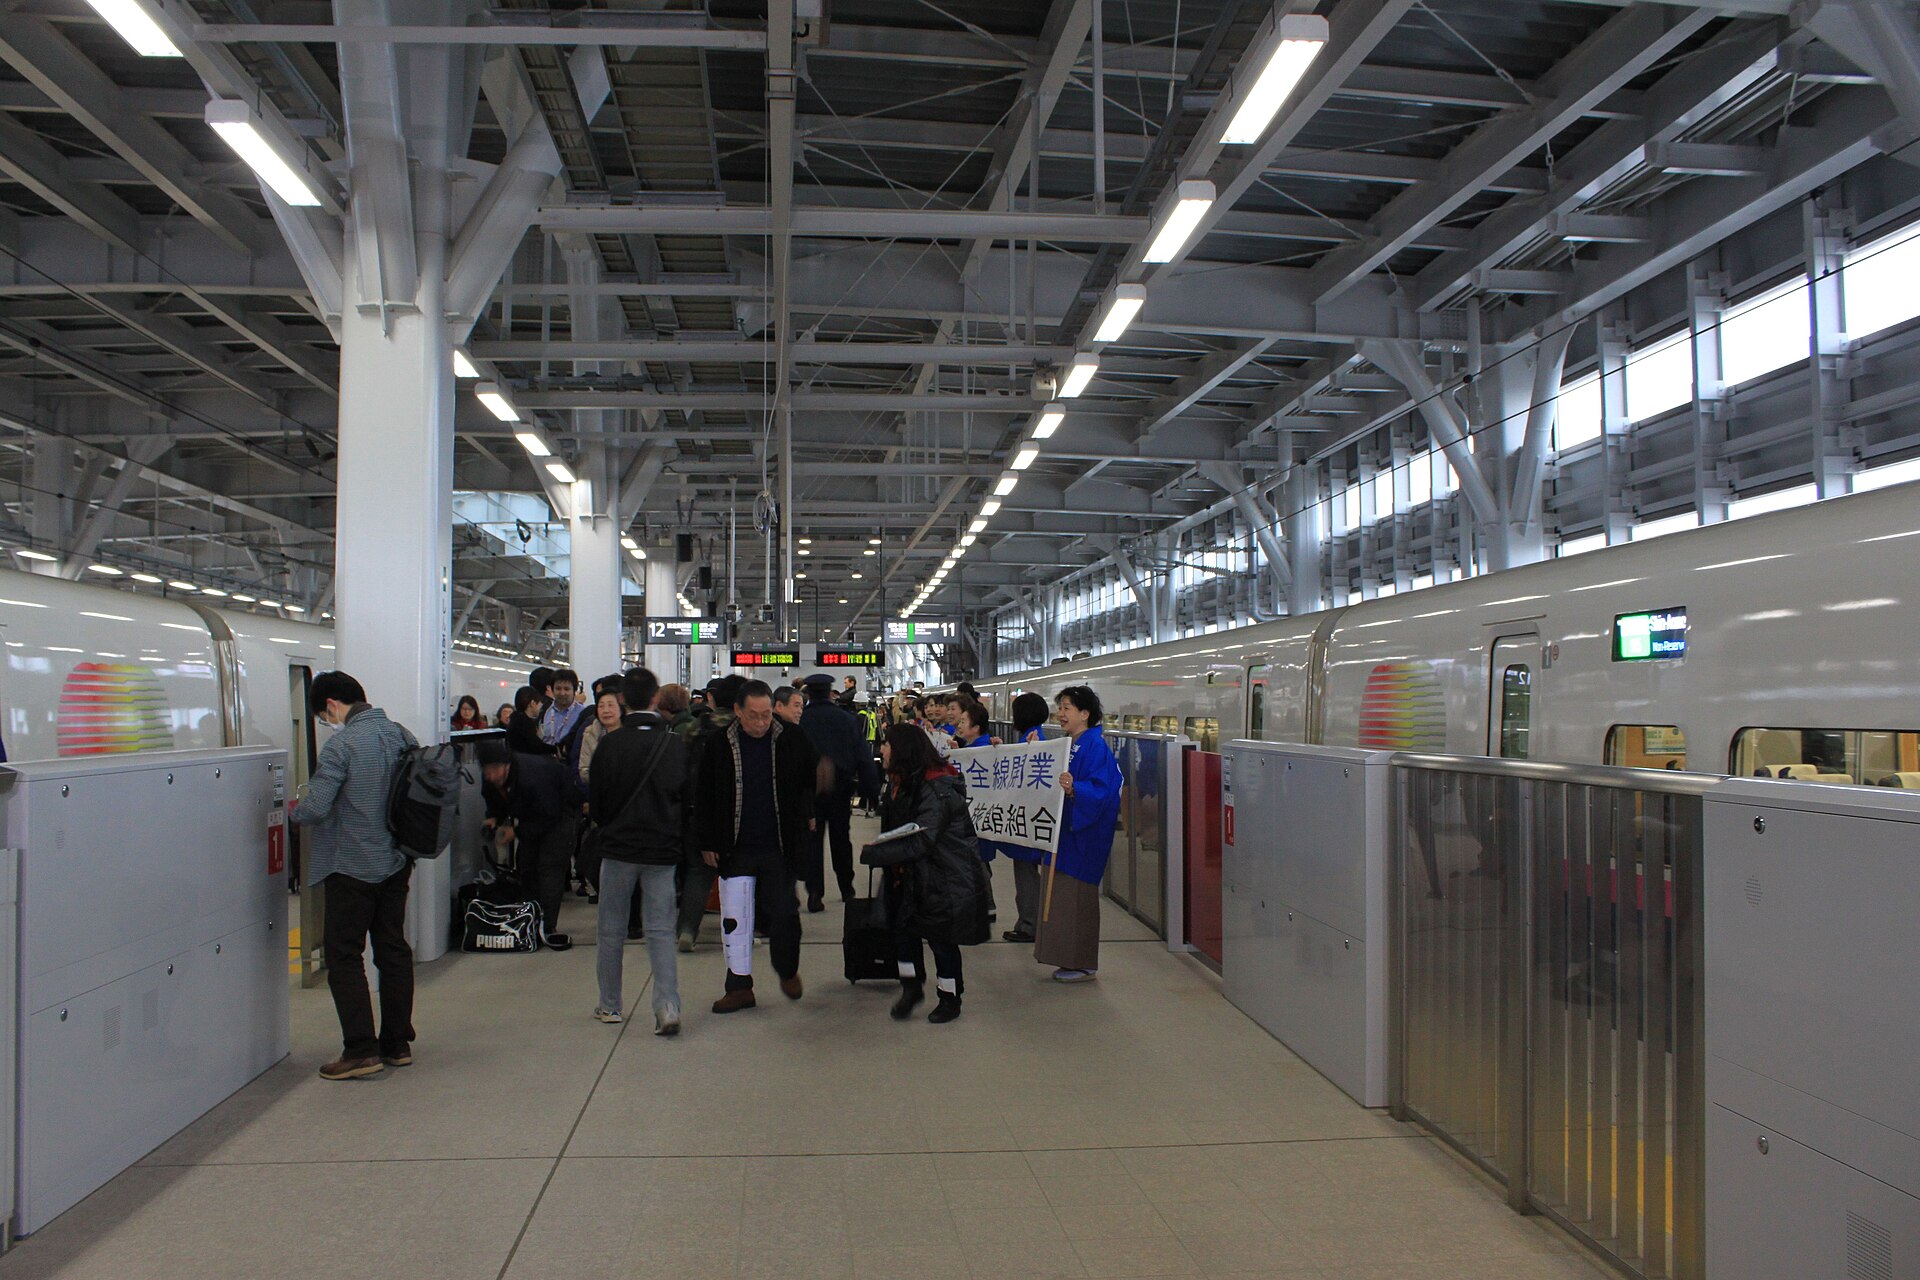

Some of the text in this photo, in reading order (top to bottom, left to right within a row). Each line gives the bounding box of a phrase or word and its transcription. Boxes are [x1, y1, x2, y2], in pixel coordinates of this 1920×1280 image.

[648, 622, 666, 638] 12
[941, 622, 955, 638] 11
[732, 643, 743, 651] 12
[874, 643, 882, 651] 11
[1544, 649, 1549, 666] 1
[966, 796, 1057, 843] 旅館組合
[272, 831, 278, 860] 1
[476, 934, 515, 949] PUMA
